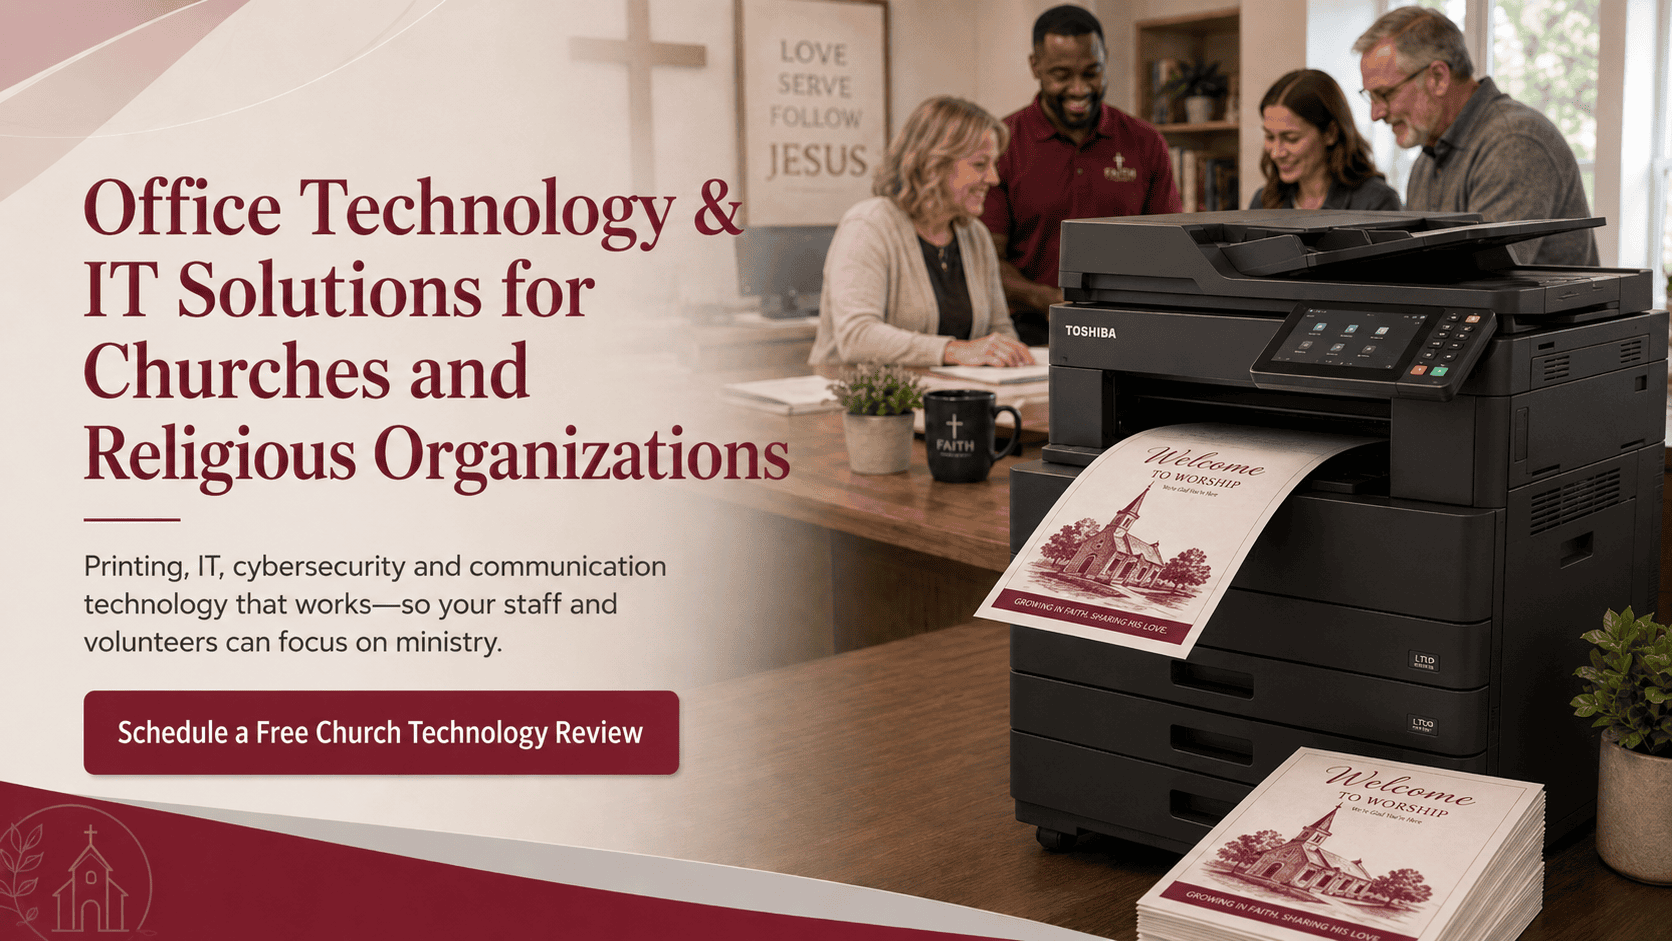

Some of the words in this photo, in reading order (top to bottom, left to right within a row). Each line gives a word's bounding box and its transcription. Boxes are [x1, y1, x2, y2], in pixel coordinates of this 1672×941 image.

[780, 39, 847, 66] LOVE
[777, 72, 852, 99] SERVE
[770, 104, 863, 129] FOLLOW
[765, 142, 869, 182] JESUS
[1065, 324, 1117, 339] TOSHIBA
[936, 438, 975, 452] FAITH
[1144, 446, 1266, 476] Welcome
[1151, 469, 1171, 480] TO
[1175, 472, 1241, 489] WORSHIP
[1014, 597, 1053, 611] GROWING
[1090, 612, 1128, 626] SHARING
[1128, 620, 1142, 629] HIS
[1325, 765, 1476, 806] Welcome
[1338, 791, 1362, 802] TO
[1367, 796, 1449, 818] WORSHIP
[1186, 890, 1235, 908] GROWING
[1235, 902, 1247, 911] IN
[1281, 913, 1329, 931] SHARING
[1329, 925, 1350, 936] HIS
[1350, 930, 1380, 941] LOVE
